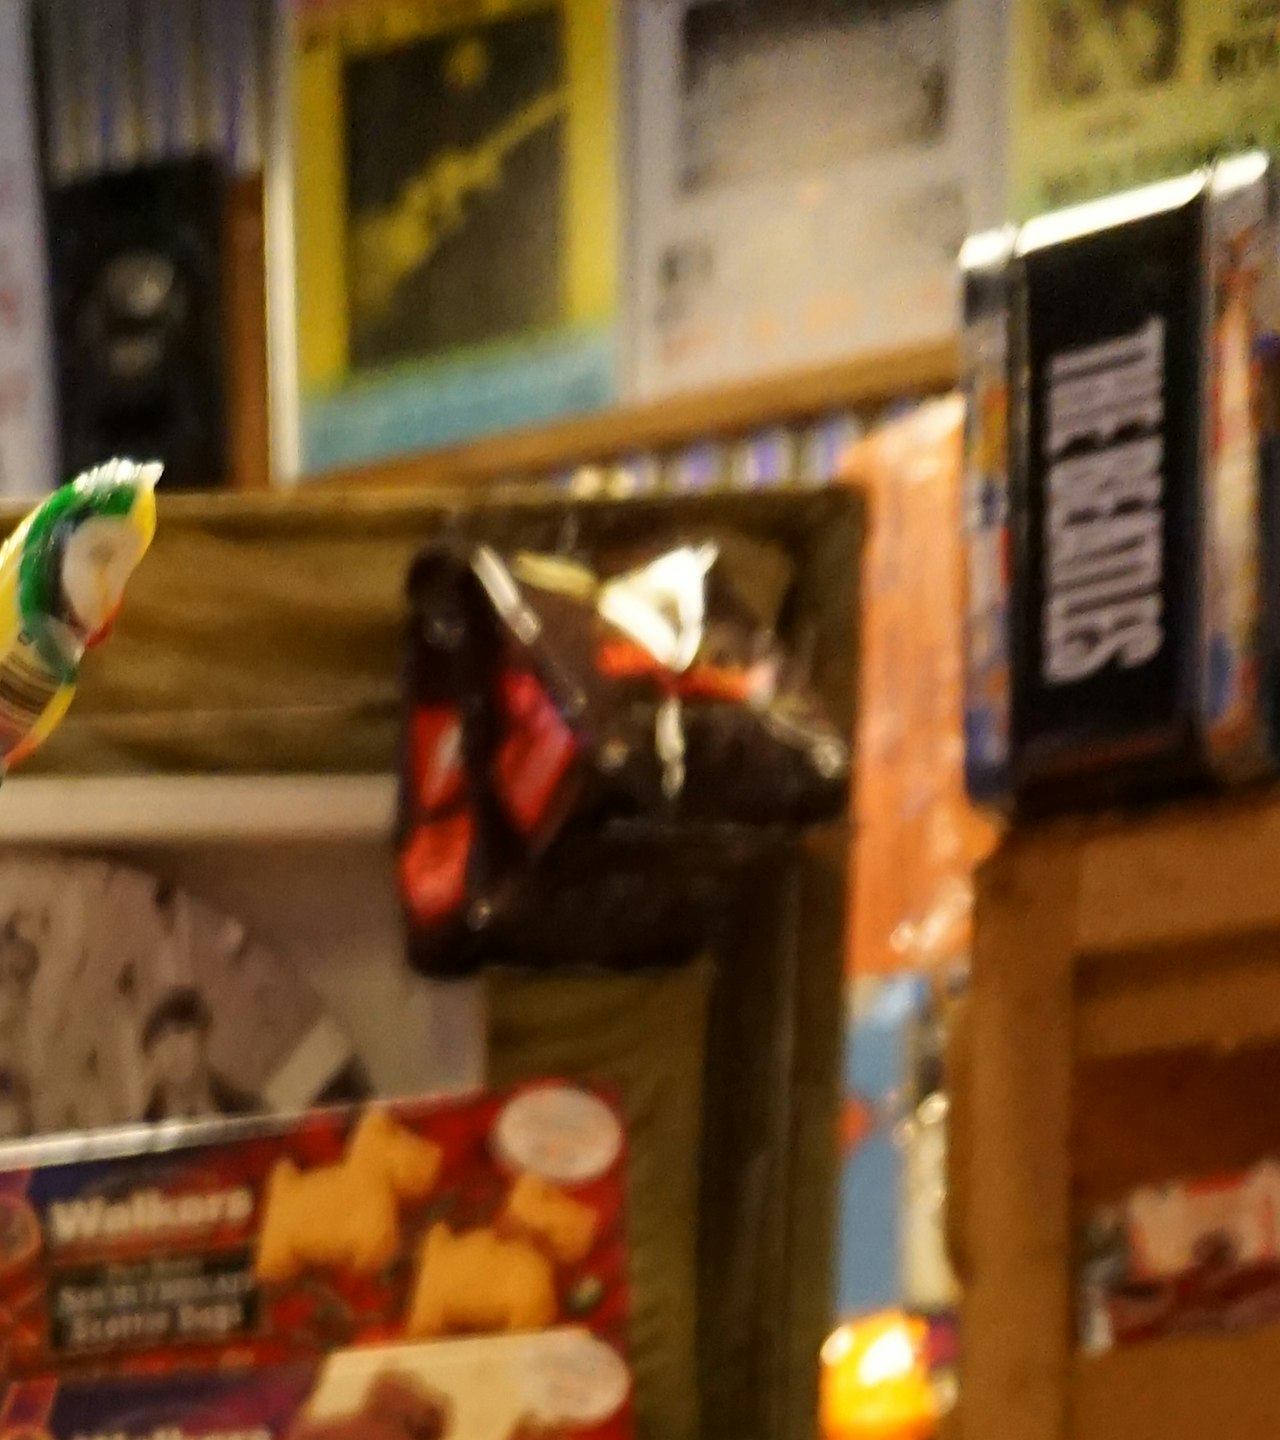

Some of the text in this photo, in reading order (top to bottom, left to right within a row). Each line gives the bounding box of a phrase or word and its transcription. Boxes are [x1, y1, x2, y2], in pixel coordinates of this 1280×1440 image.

[1041, 316, 1165, 684] THE BEATLES
[50, 1187, 255, 1241] Walkers
